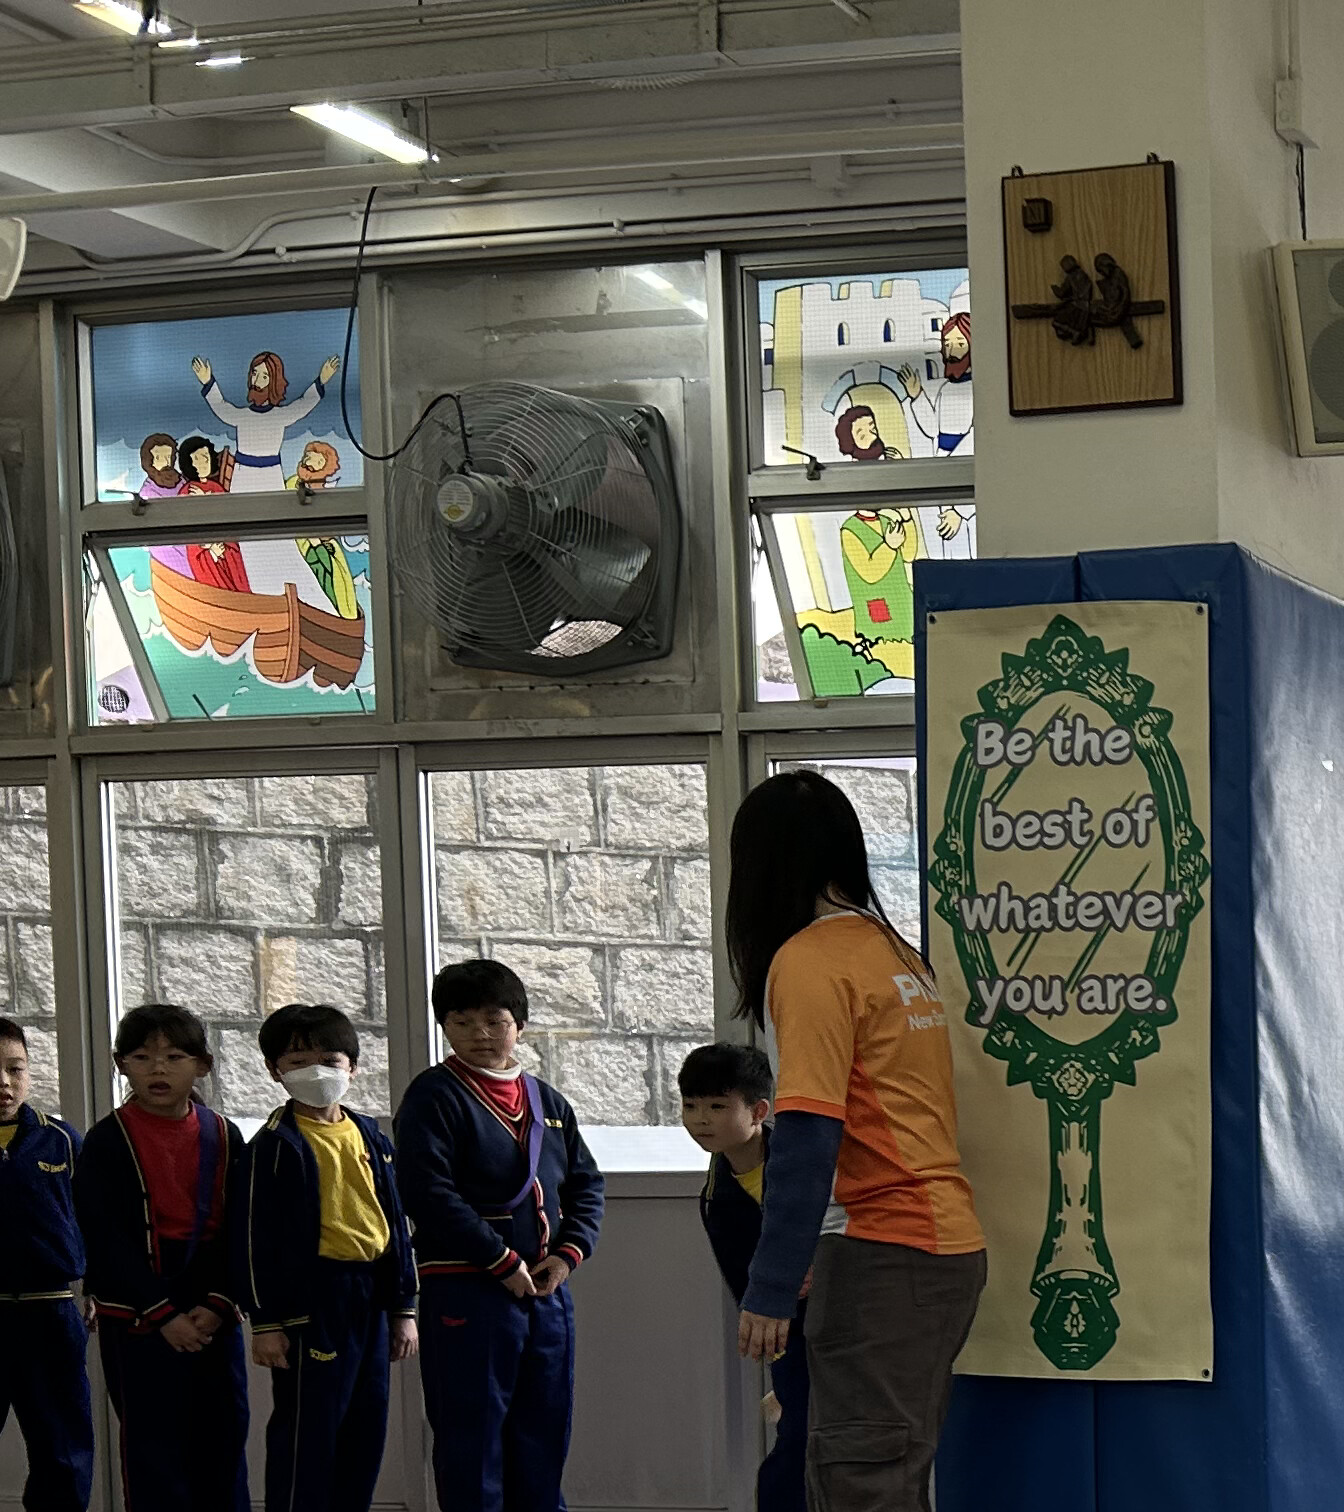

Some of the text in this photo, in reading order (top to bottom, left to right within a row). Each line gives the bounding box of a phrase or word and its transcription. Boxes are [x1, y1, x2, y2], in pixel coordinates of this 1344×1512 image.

[975, 715, 1132, 767] Be the
[981, 794, 1157, 850] best of
[959, 882, 1185, 932] whatever
[976, 975, 1067, 1024] you
[1079, 975, 1169, 1015] are.
